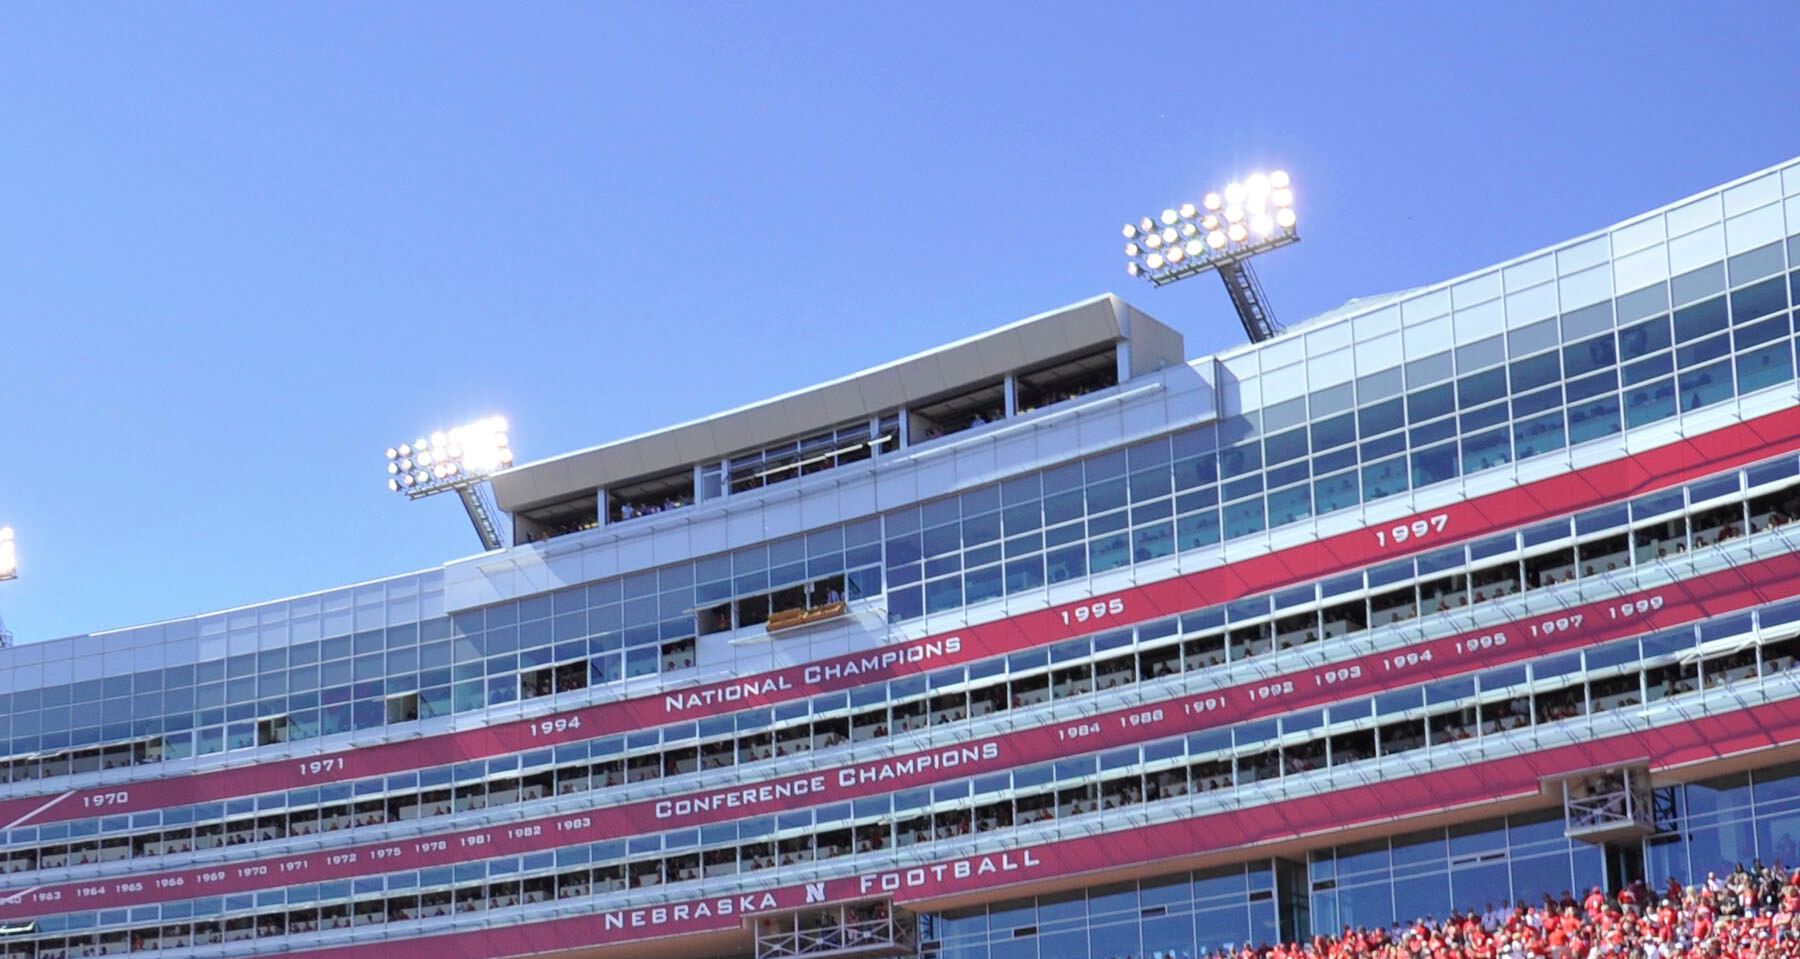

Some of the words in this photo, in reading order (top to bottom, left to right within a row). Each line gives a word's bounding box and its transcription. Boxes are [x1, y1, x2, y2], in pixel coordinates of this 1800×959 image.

[32, 891, 61, 902] 1963
[77, 886, 106, 897] 1964
[116, 882, 143, 893] 1965
[156, 876, 185, 888] 1966
[196, 871, 226, 883] 1969
[238, 865, 268, 877] 1970
[279, 860, 308, 872] 1971
[326, 853, 357, 865] 1972
[370, 847, 402, 859] 1975
[415, 840, 447, 853] 1978
[460, 834, 491, 847] 1981
[508, 825, 542, 839] 1982
[557, 817, 591, 831] 1983
[838, 742, 999, 788] CHAMPIONS
[1058, 722, 1100, 740] 1984
[1120, 709, 1164, 728] 1988
[1184, 696, 1226, 715] 1991
[1249, 681, 1294, 701] 1992
[1315, 665, 1362, 686] 1993
[1383, 649, 1433, 671] 1994
[1455, 632, 1507, 654] 1995
[1530, 614, 1583, 637] 1997
[1609, 595, 1664, 619] 1999
[83, 791, 129, 808] 1970
[300, 757, 344, 775] 1971
[530, 716, 581, 737] 1994
[804, 636, 961, 684] CHAMPIONS
[1061, 598, 1124, 625] 1995
[1376, 514, 1448, 547] 1997
[605, 892, 778, 931] NEBRASKA
[806, 882, 826, 903] N
[860, 849, 1042, 895] FOOTBALL
